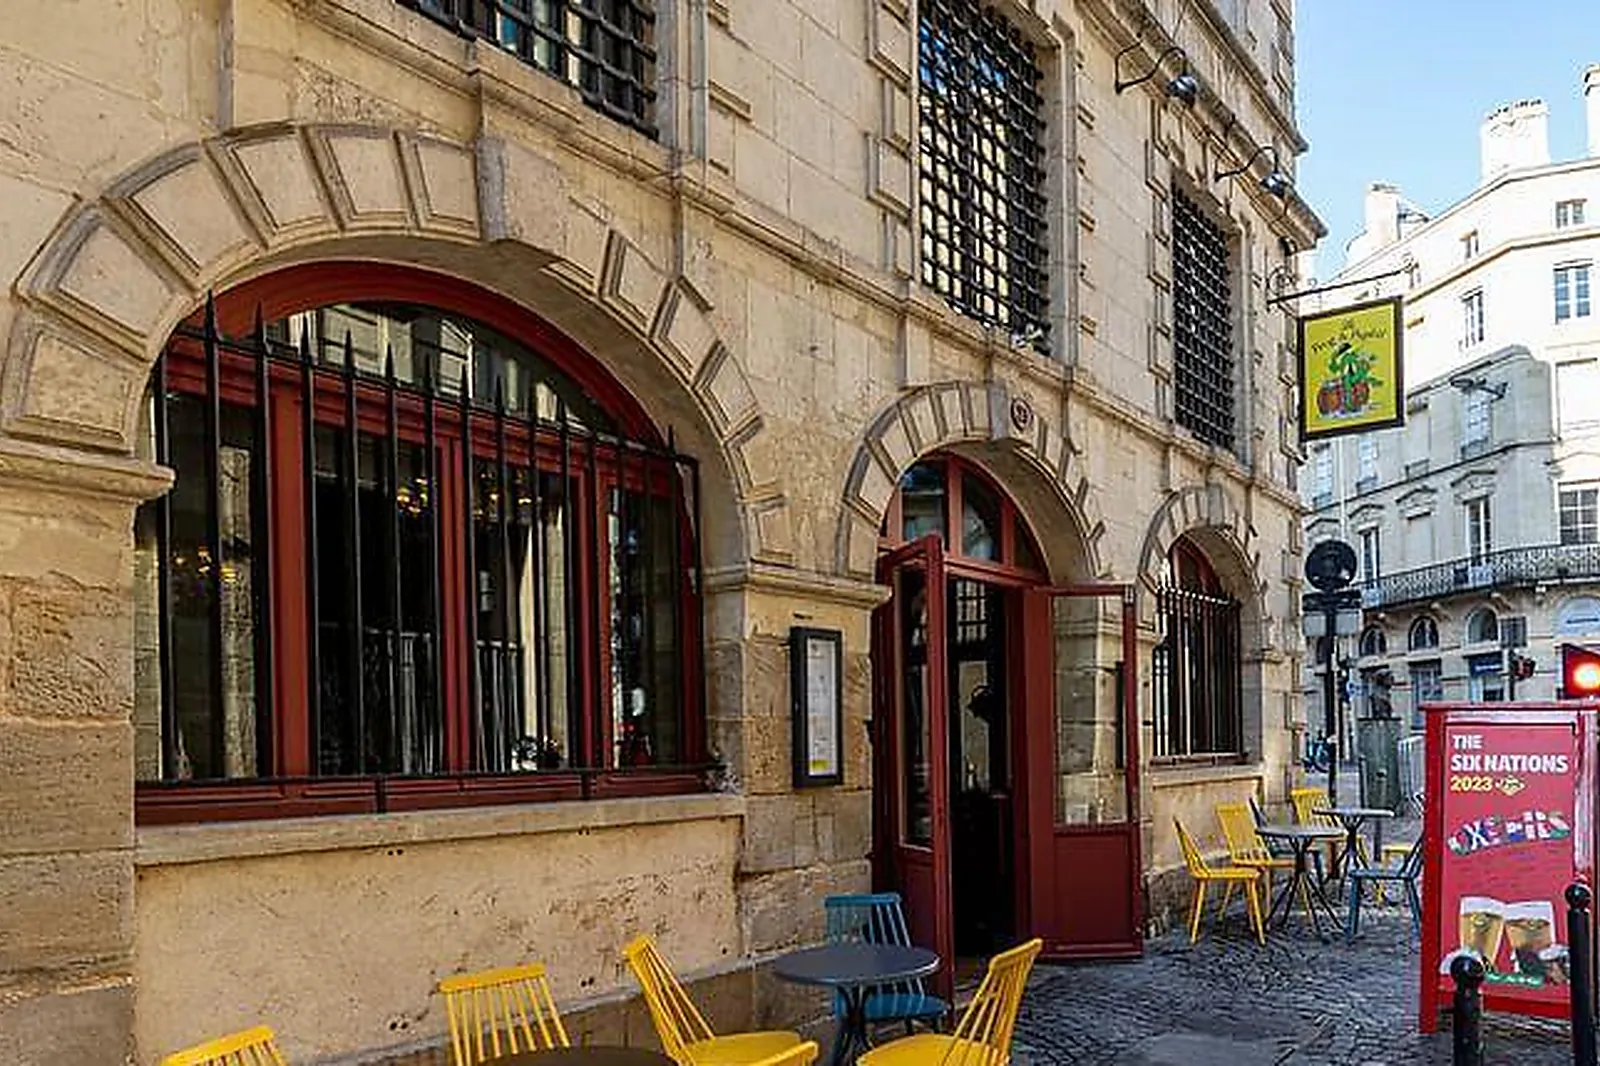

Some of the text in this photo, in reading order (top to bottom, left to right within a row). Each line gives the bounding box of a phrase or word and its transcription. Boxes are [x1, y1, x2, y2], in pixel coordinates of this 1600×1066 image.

[1452, 735, 1482, 749] THE
[1450, 755, 1568, 773] SIX NATIONS
[1450, 776, 1493, 792] 2023
